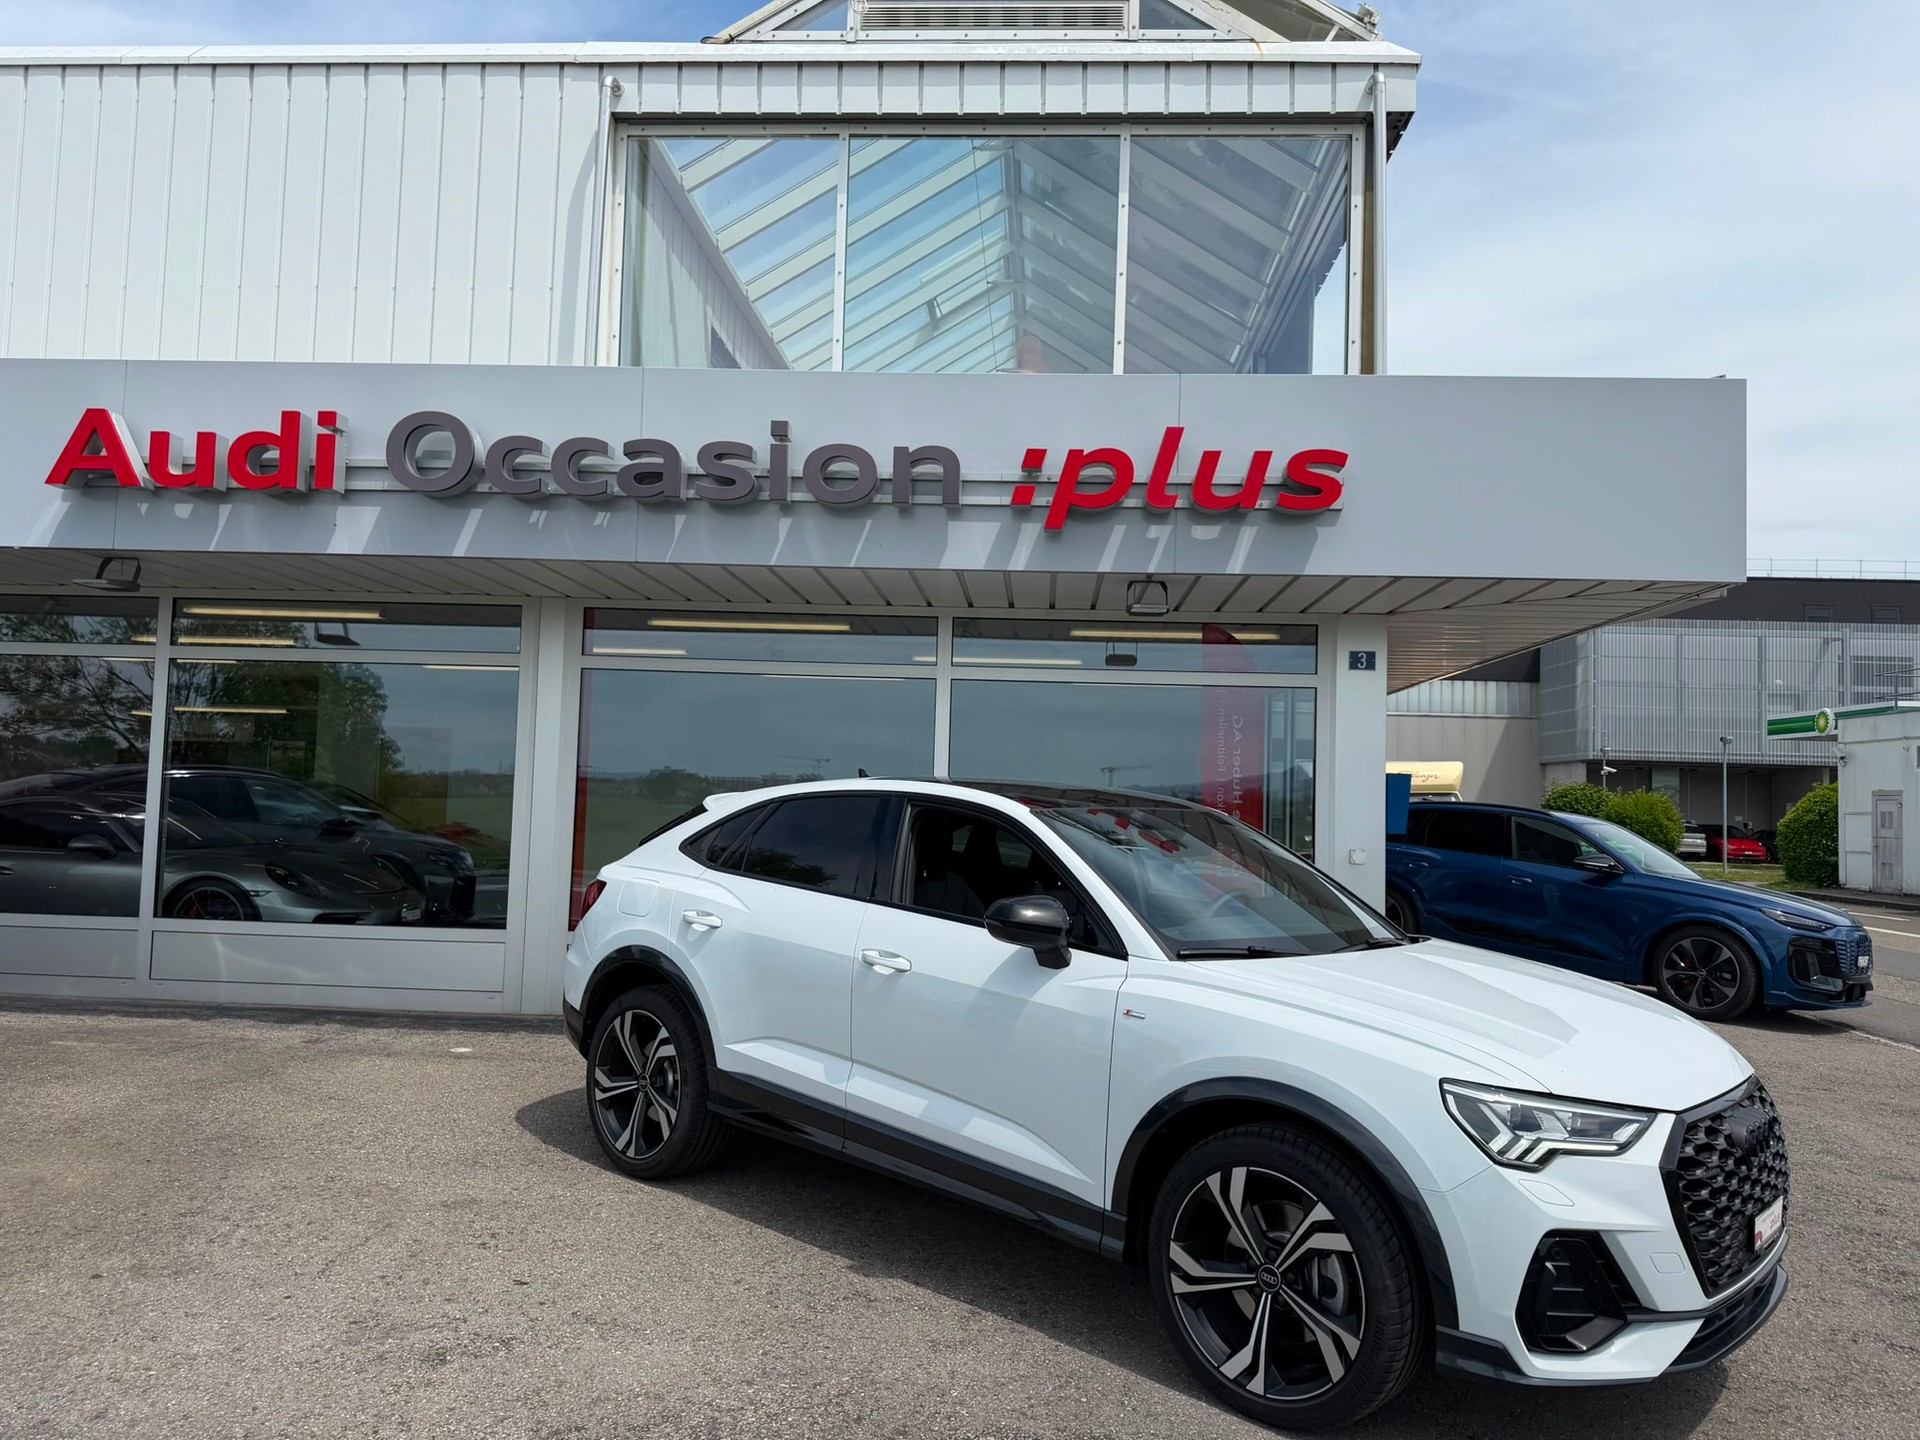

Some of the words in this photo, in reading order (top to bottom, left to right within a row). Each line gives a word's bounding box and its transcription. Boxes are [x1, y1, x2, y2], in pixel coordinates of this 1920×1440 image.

[46, 408, 338, 490] Audi
[386, 410, 960, 507] Occasion
[1357, 652, 1367, 669] 3
